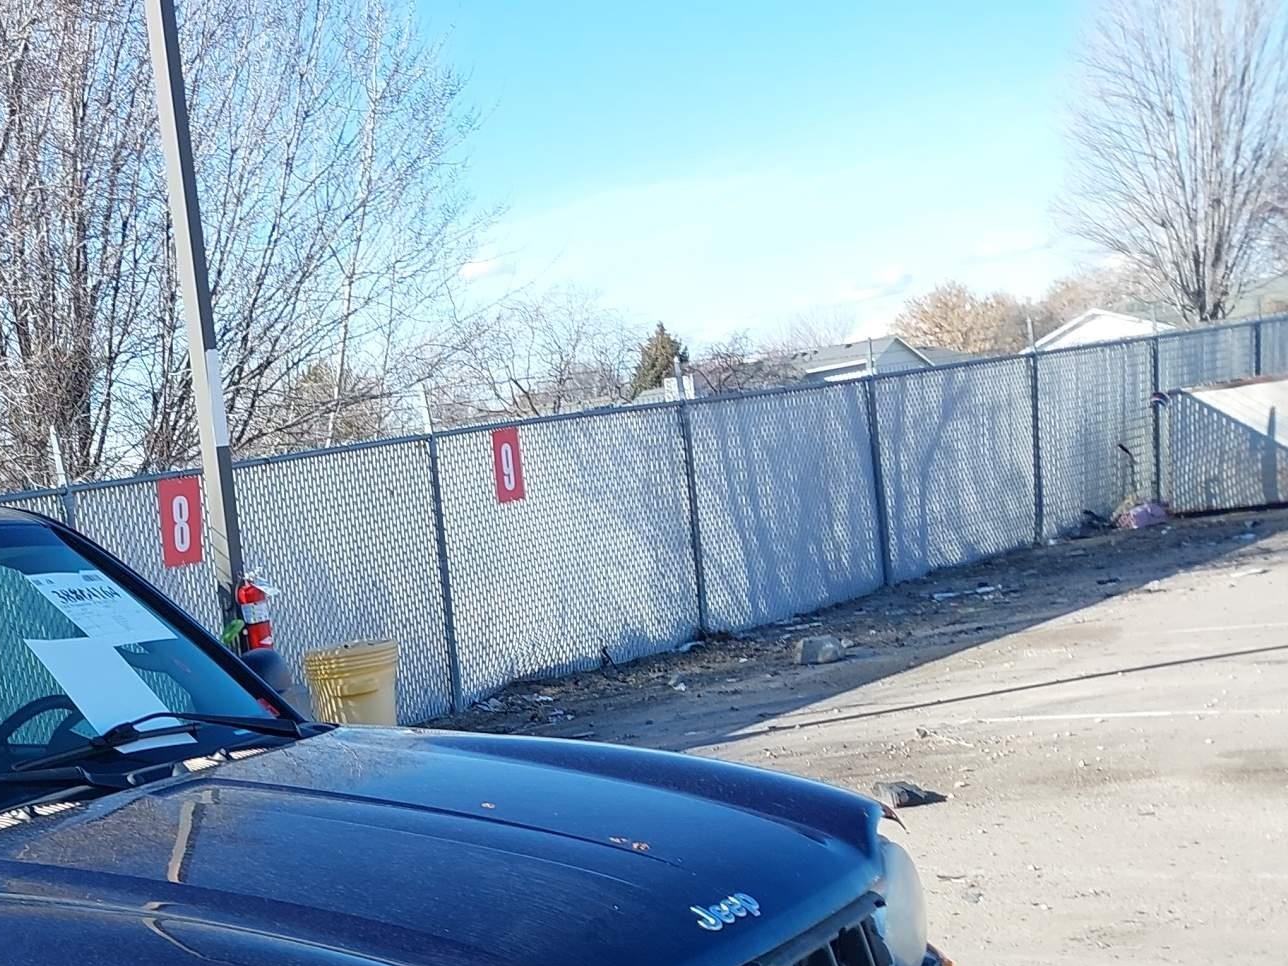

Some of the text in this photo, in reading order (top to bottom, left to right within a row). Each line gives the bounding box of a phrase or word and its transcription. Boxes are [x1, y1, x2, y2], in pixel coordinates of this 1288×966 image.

[501, 443, 516, 491] 9
[173, 495, 191, 553] 8
[690, 892, 761, 931] Jeep
